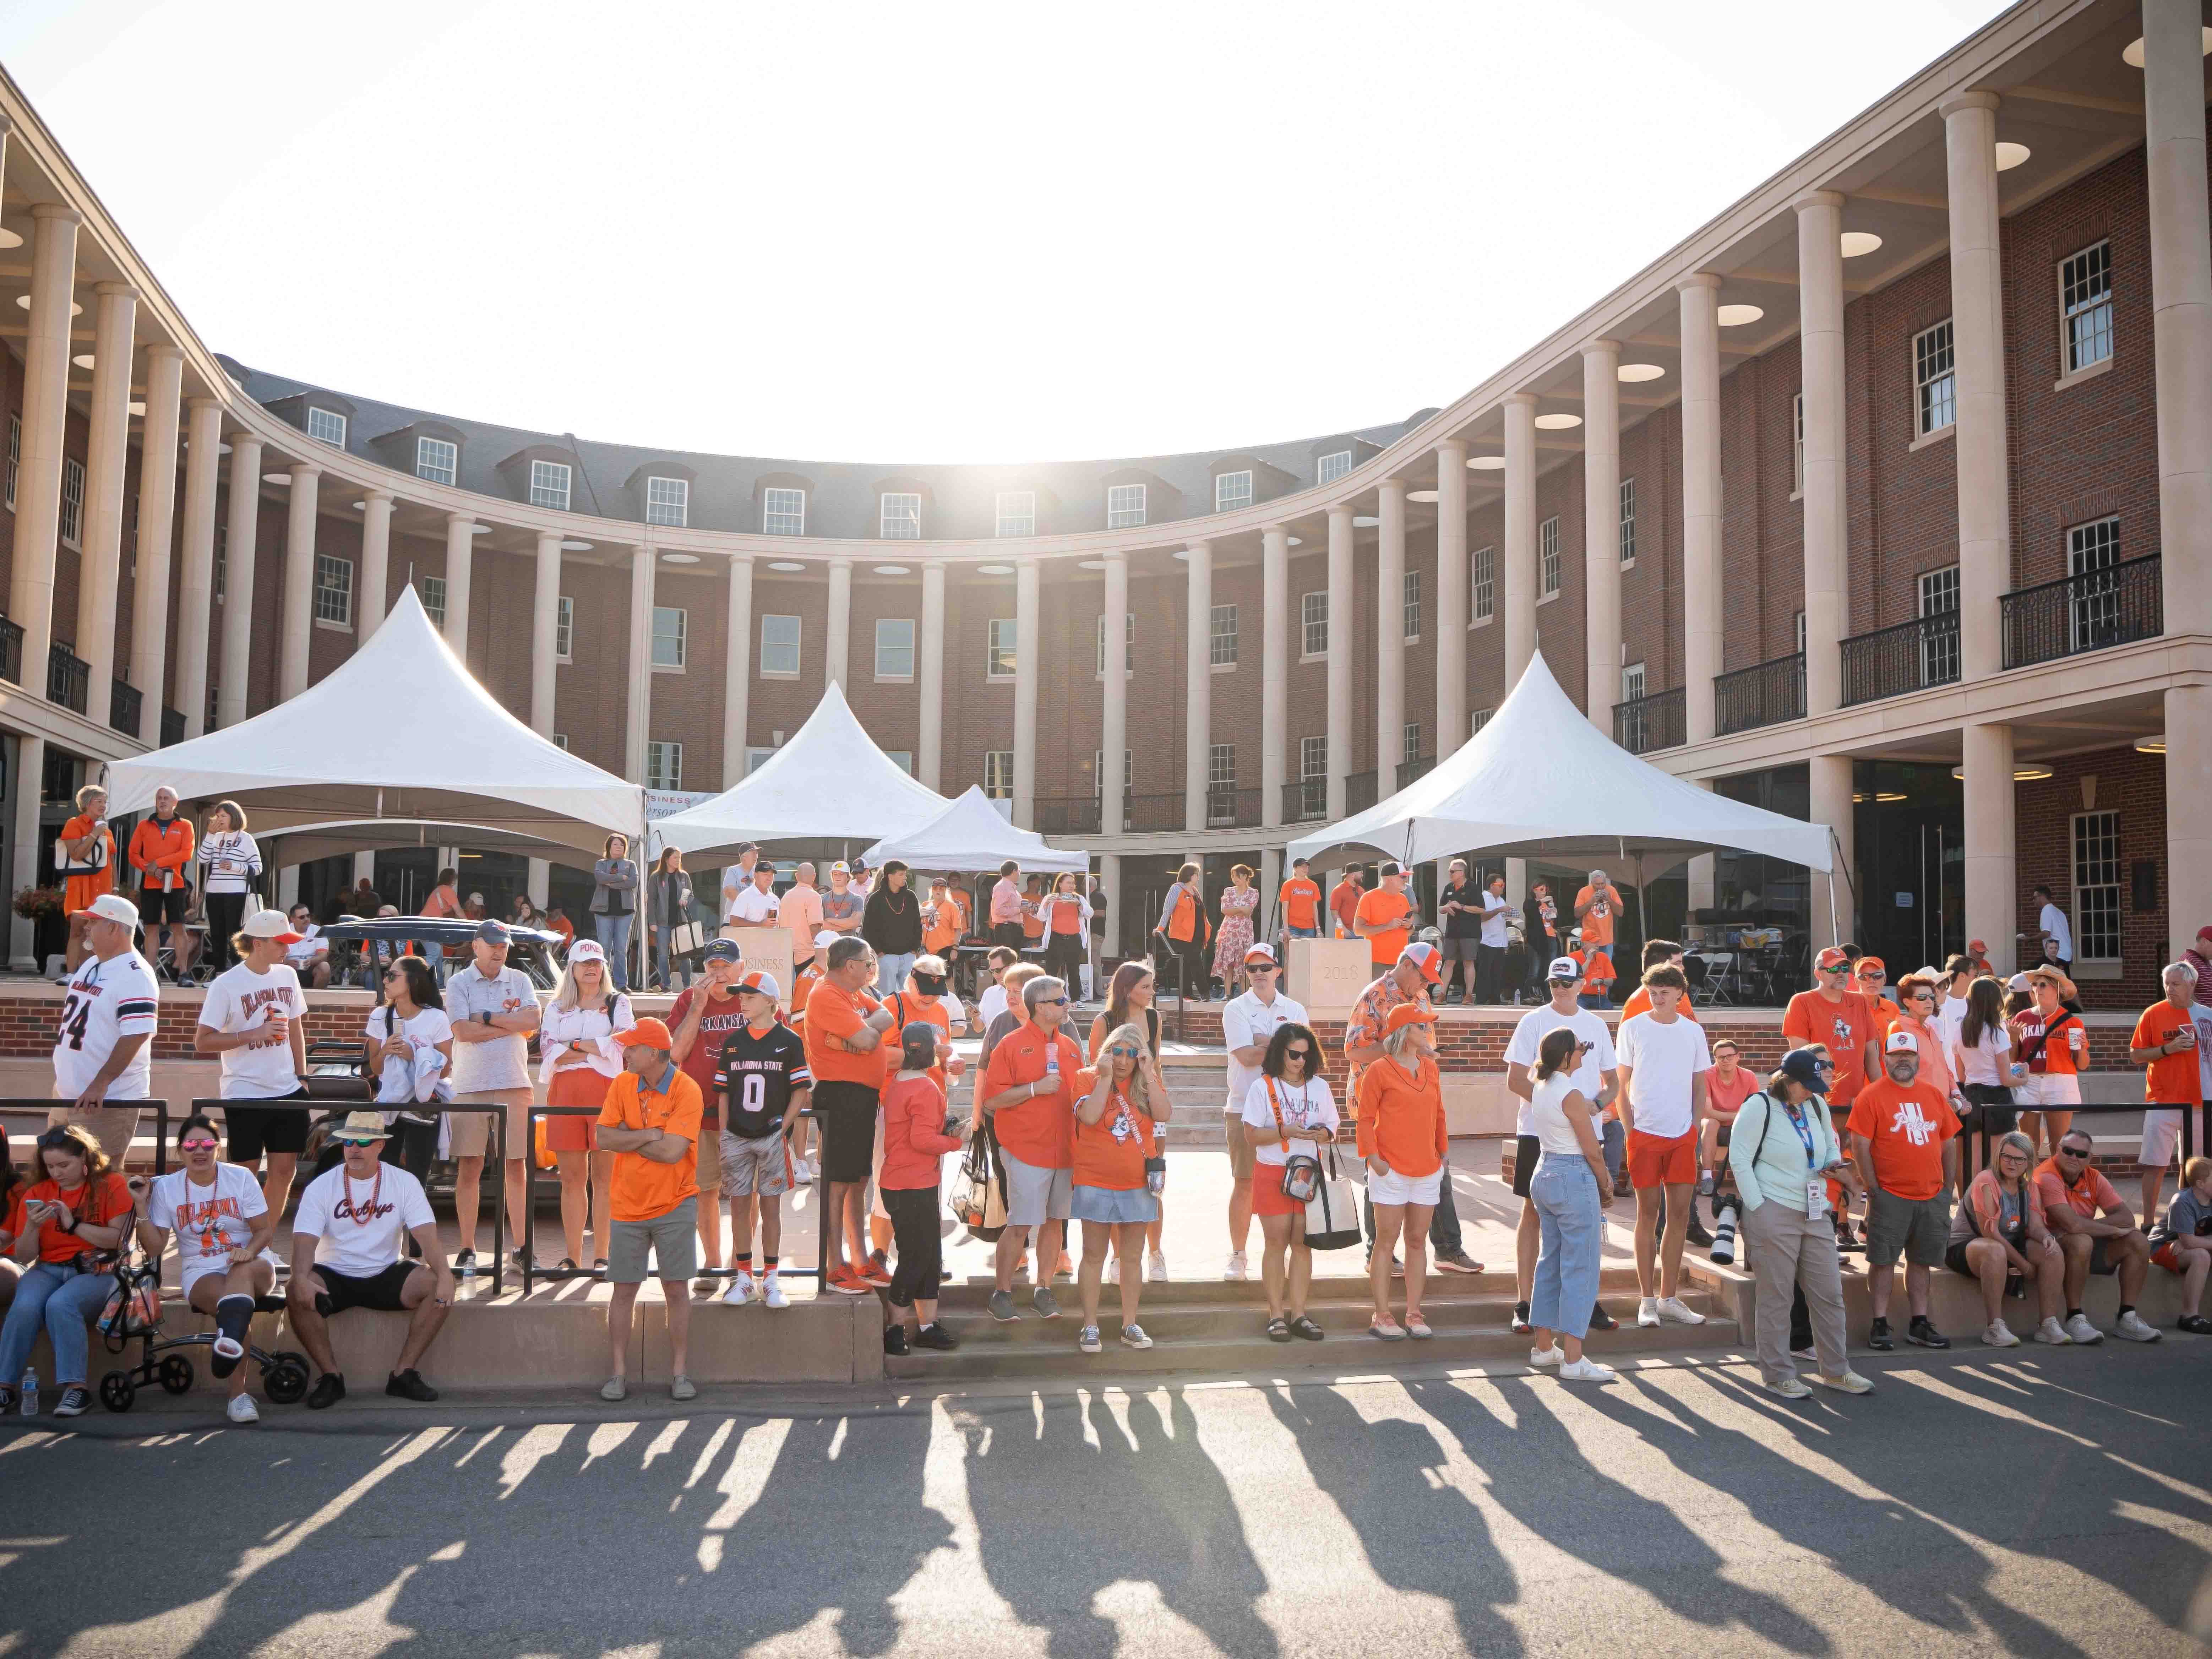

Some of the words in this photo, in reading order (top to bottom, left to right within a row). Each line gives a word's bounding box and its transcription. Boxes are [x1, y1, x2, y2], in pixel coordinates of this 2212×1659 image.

[648, 795, 691, 804] SINESS
[219, 837, 242, 848] OSU
[580, 943, 602, 953] POKE
[1323, 965, 1358, 980] 2018
[241, 987, 278, 1021] OKLAHOMA
[53, 994, 92, 1051] 24
[700, 1013, 752, 1033] RKANSA
[730, 1060, 762, 1071] OKLAHOMA
[763, 1061, 783, 1071] STATE
[743, 1073, 766, 1112] 0
[1279, 1097, 1319, 1114] KLAHOMA
[1116, 1094, 1134, 1120] PISTOLS
[1128, 1119, 1143, 1144] FIRING
[1890, 1112, 1938, 1132] Pokes
[176, 1196, 242, 1231] OKLAHOMA
[333, 1198, 396, 1219] Cowboys
